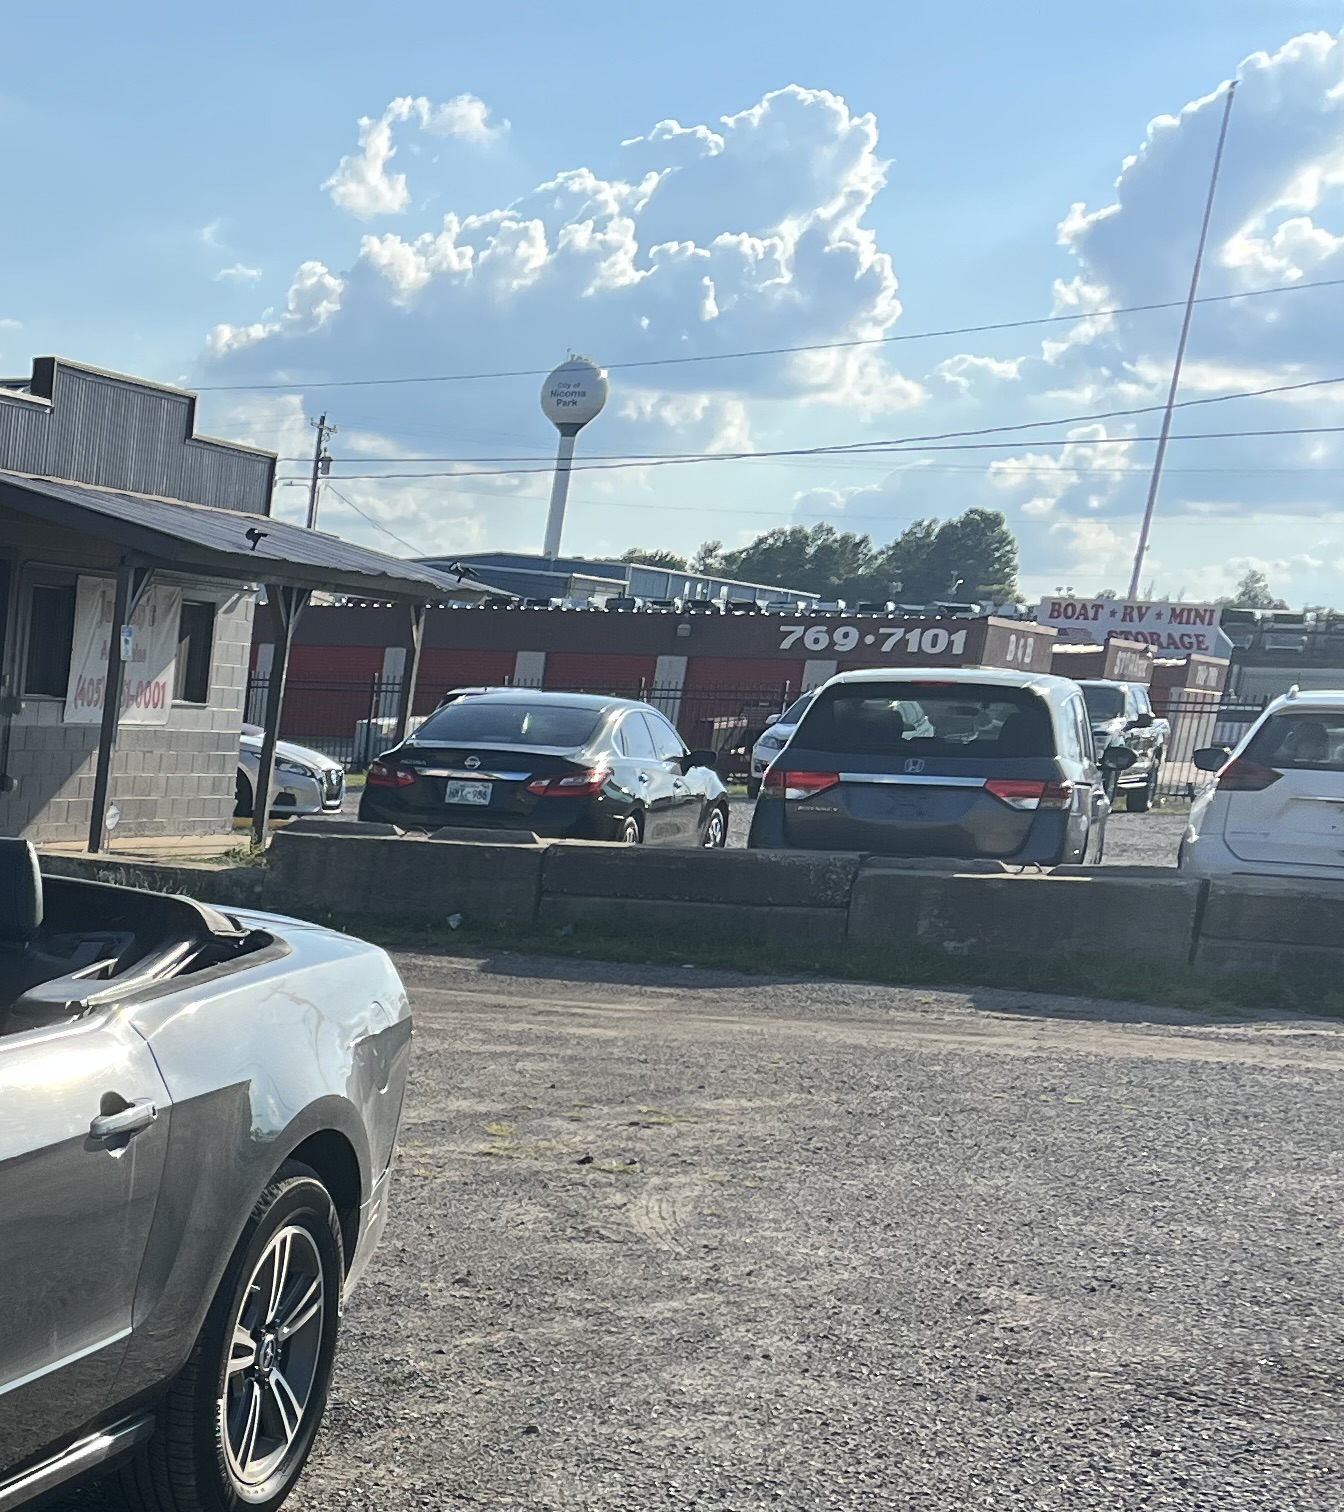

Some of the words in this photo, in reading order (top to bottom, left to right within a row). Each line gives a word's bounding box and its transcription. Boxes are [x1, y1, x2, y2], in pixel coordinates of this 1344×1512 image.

[550, 390, 586, 398] Nicoma
[556, 399, 577, 407] Park
[1048, 602, 1104, 621] BOAT
[1121, 605, 1152, 623] RV
[1168, 607, 1216, 626] MINI
